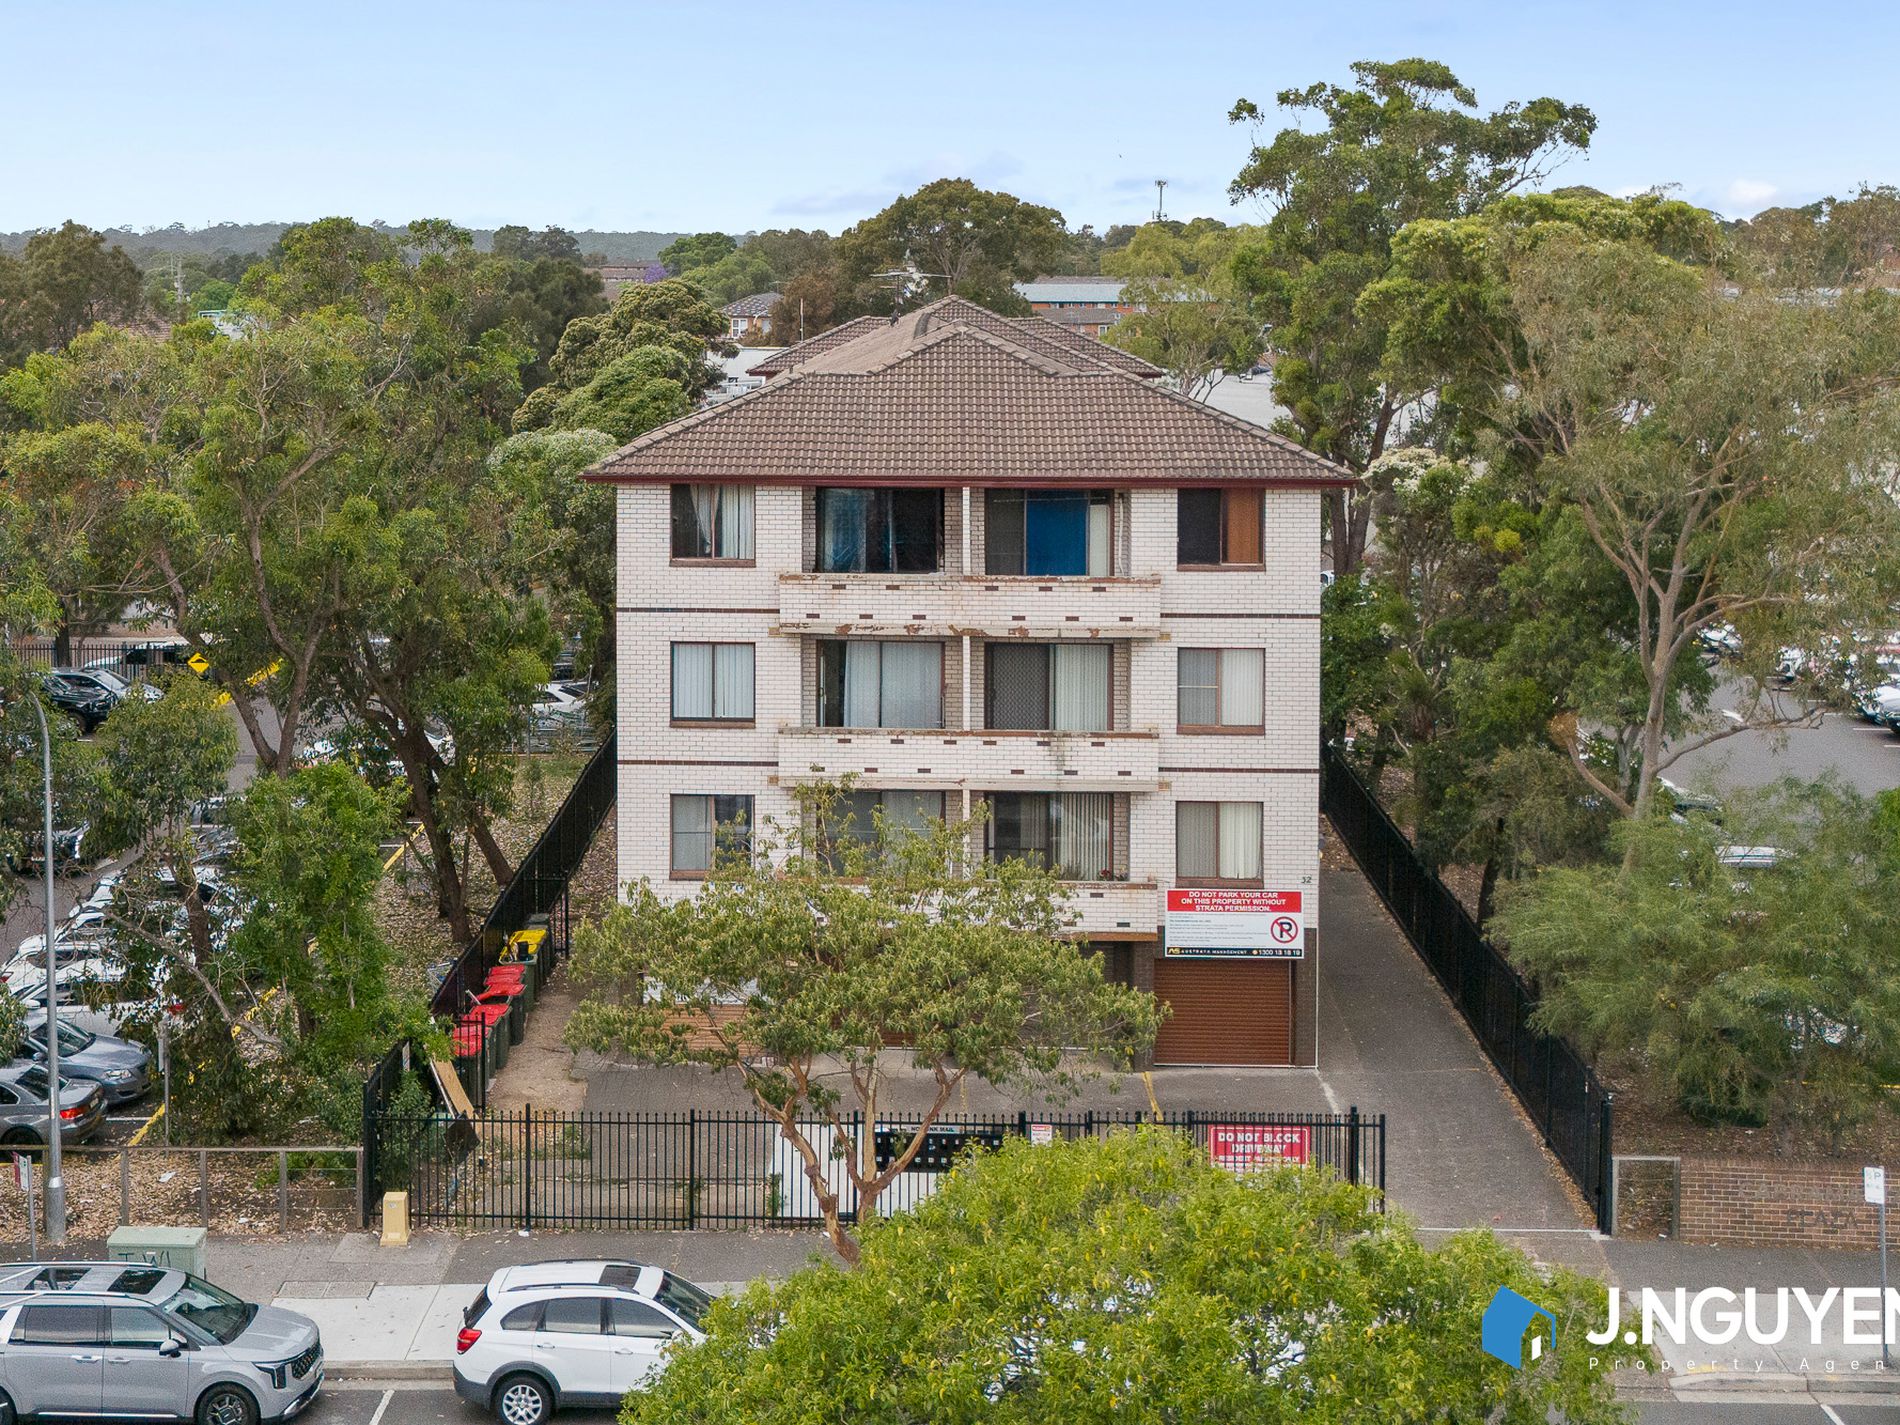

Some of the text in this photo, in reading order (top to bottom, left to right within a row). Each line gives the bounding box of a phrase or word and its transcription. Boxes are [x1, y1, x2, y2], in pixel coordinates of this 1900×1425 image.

[1301, 876, 1312, 884] 32
[1218, 1132, 1300, 1143] DO NOT BLOCK
